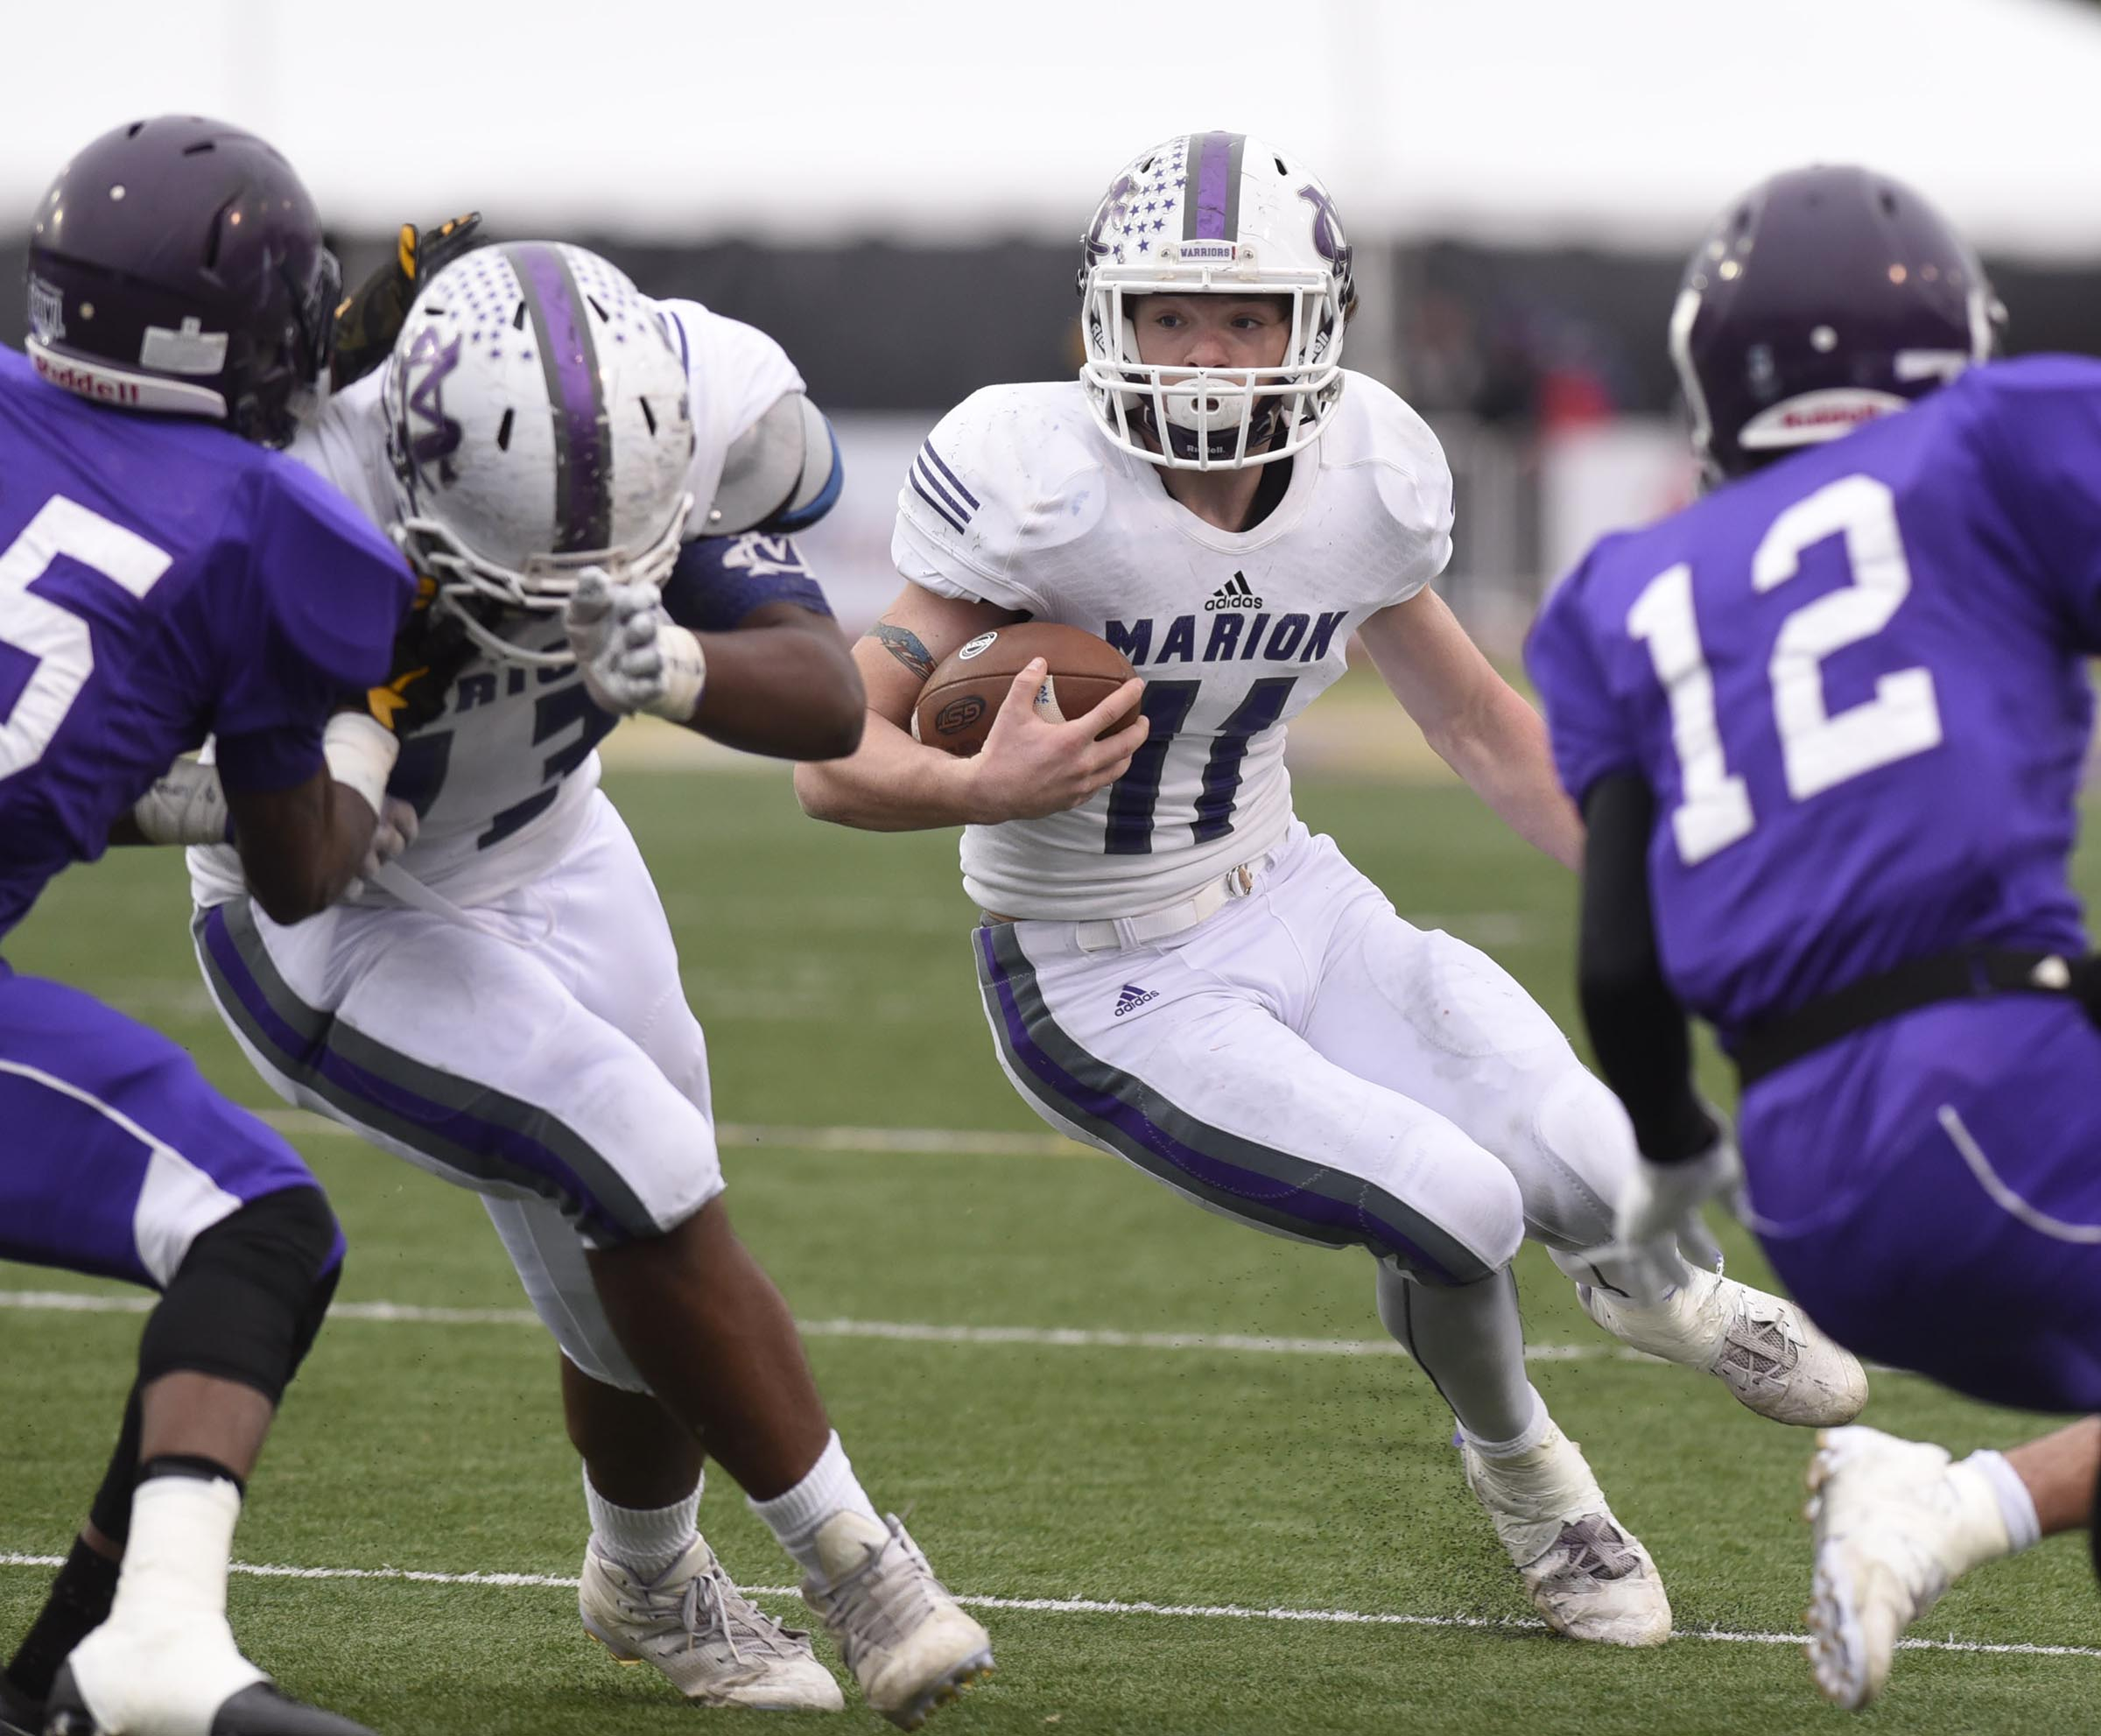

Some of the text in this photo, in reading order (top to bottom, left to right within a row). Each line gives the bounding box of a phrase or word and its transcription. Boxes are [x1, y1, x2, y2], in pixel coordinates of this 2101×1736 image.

[1204, 594, 1263, 611] adidas
[1105, 610, 1349, 666] MARION
[1627, 473, 1943, 865] 12
[1104, 676, 1299, 854] 11
[1114, 990, 1160, 1017] adidas
